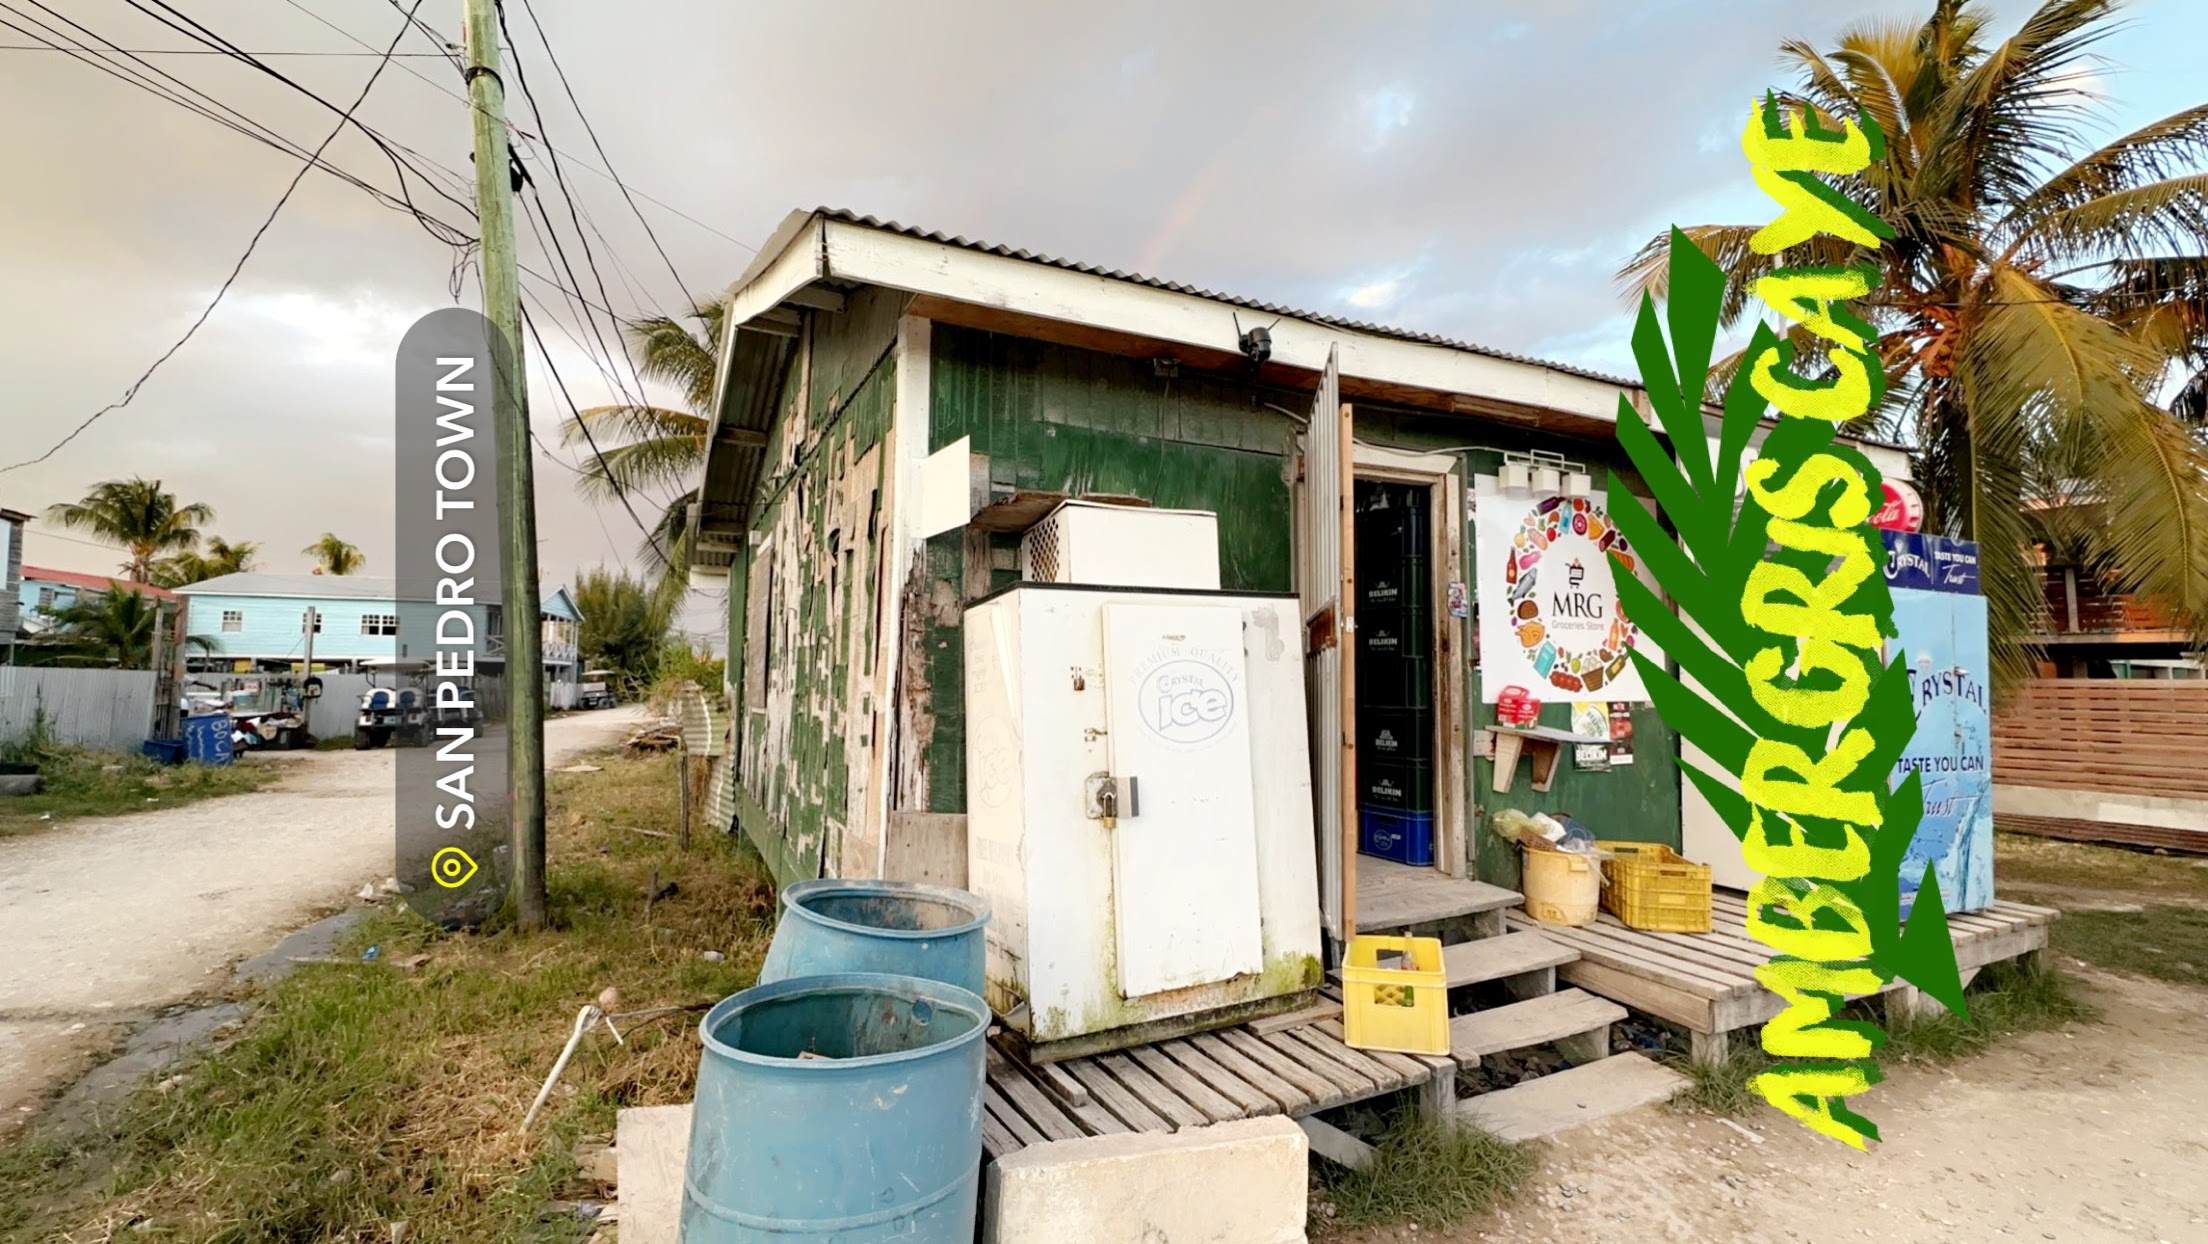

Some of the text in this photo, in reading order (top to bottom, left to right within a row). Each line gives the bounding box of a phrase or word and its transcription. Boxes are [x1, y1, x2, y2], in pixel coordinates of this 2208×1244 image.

[1934, 551, 1977, 565] TASTE YOU CAN
[1942, 564, 1976, 584] Trust
[1552, 592, 1603, 619] MRG
[1552, 620, 1604, 631] Groceries Store
[1934, 757, 1958, 773] YOU
[1961, 756, 1984, 771] CAN
